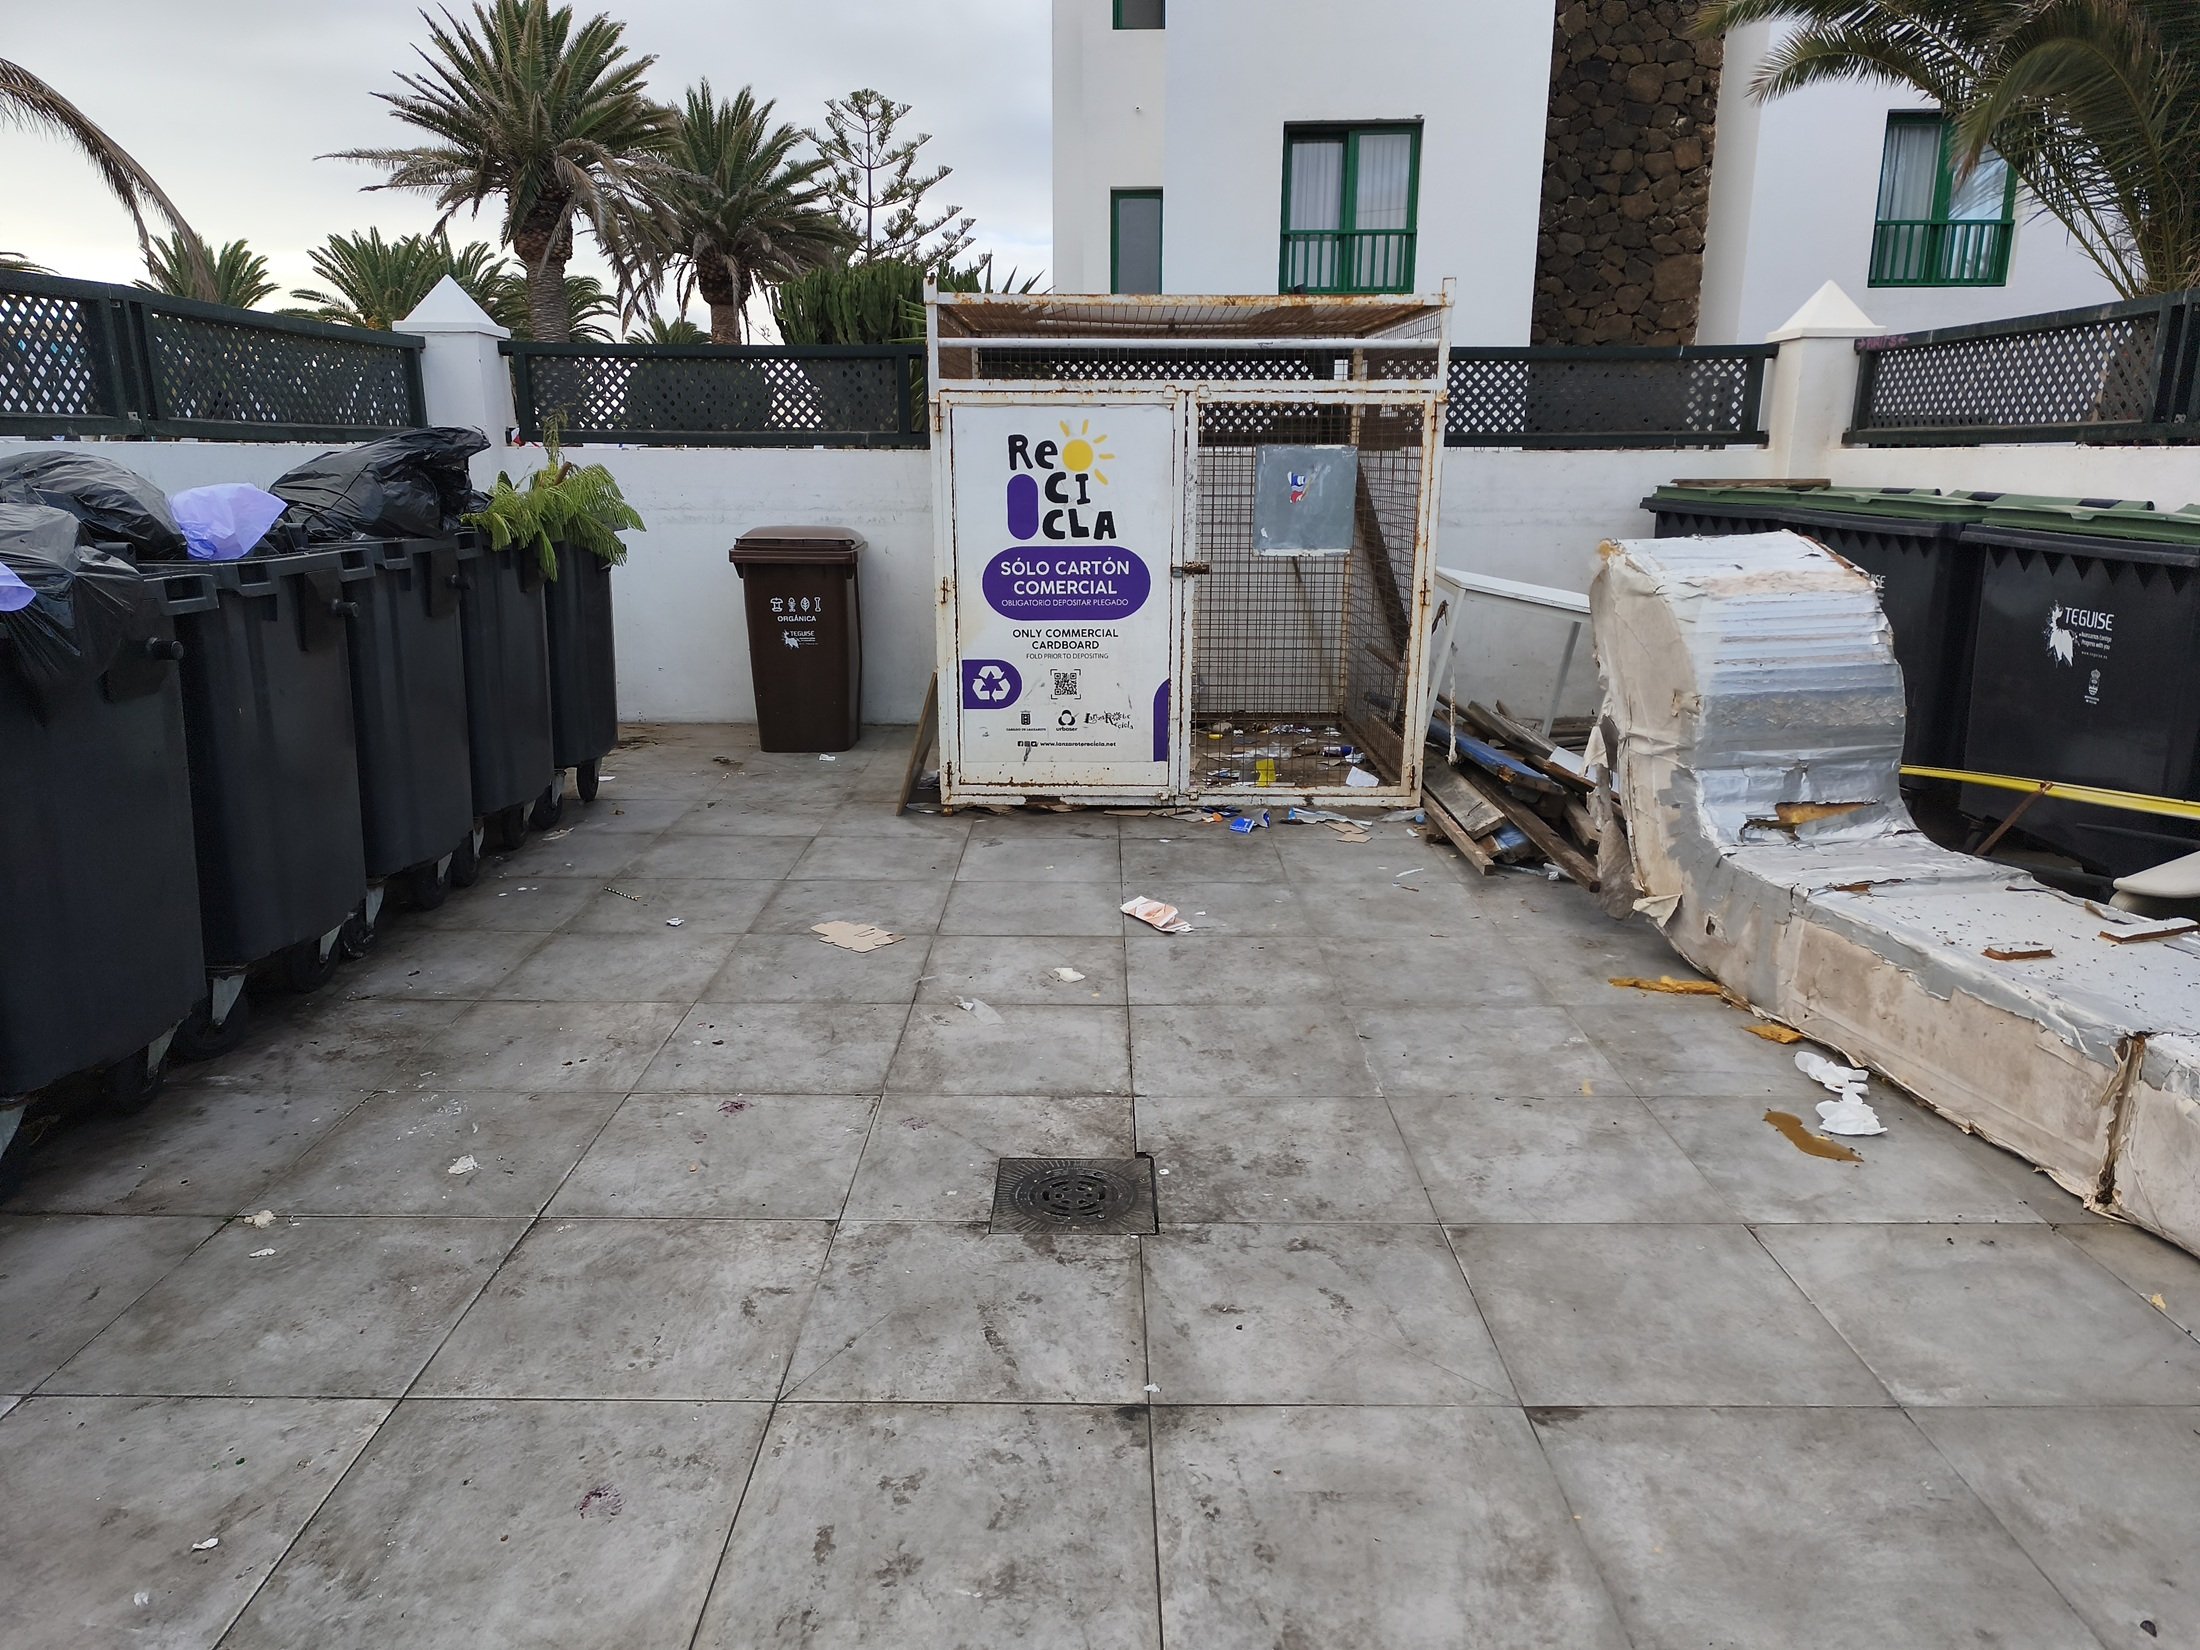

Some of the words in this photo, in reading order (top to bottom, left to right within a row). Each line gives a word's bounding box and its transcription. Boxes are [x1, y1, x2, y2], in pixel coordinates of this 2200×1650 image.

[1000, 557, 1050, 576] SÓLO
[1055, 556, 1130, 575] CARTÓN
[1013, 580, 1118, 595] COMERCIAL
[1001, 599, 1051, 607] OBLIGATORIO
[1093, 598, 1129, 606] PLEGADO
[777, 614, 817, 622] ORGÁNICA
[2064, 607, 2115, 631] TEGUISE
[1012, 629, 1042, 638] ONLY
[1045, 629, 1119, 638] COMMERCIAL
[1031, 640, 1100, 650] CARDBOARD
